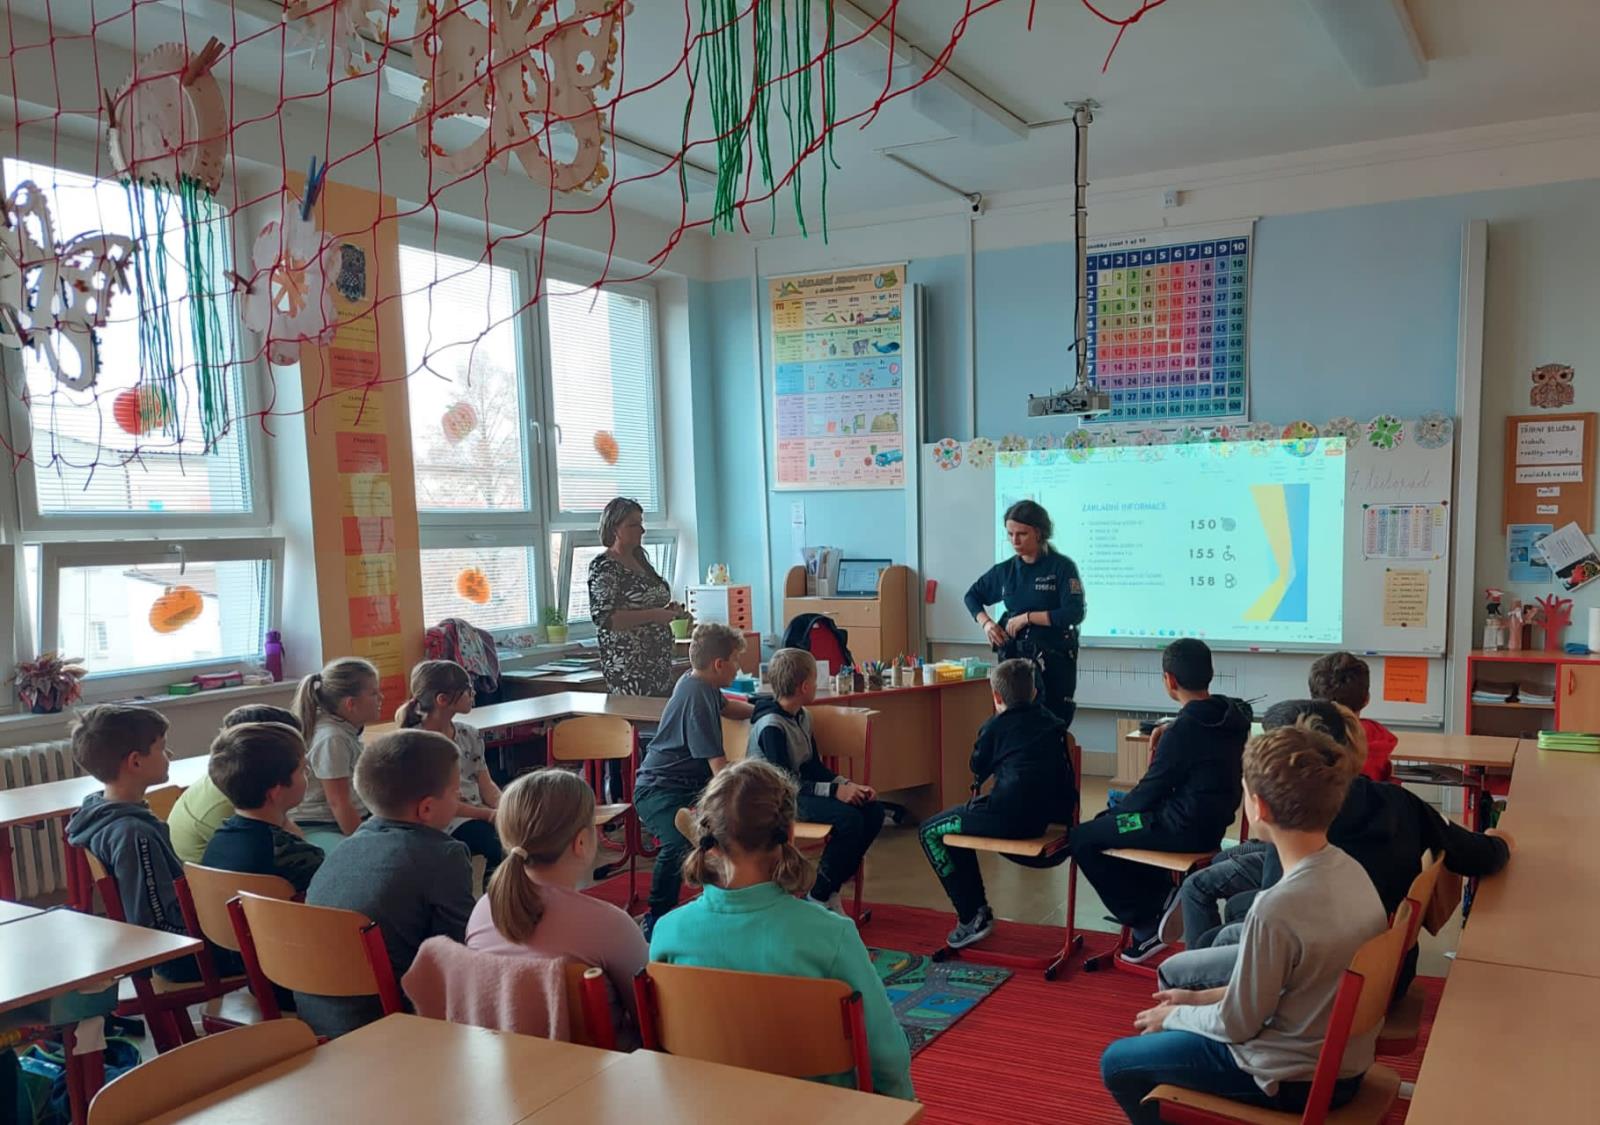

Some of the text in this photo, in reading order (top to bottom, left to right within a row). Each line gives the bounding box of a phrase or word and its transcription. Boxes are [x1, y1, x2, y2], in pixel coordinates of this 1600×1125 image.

[1116, 256, 1123, 264] 2
[1131, 254, 1137, 263] 3
[1159, 251, 1166, 259] 5
[1174, 249, 1181, 257] 6
[1189, 247, 1196, 256] 7
[1204, 246, 1212, 254] 8
[1218, 244, 1226, 252] 9
[1232, 242, 1244, 250] 10
[1081, 501, 1167, 512] ZÁKLADNÍ INFORMACE
[1190, 519, 1216, 530] 150
[1189, 548, 1214, 559] 155
[1190, 576, 1215, 586] 158
